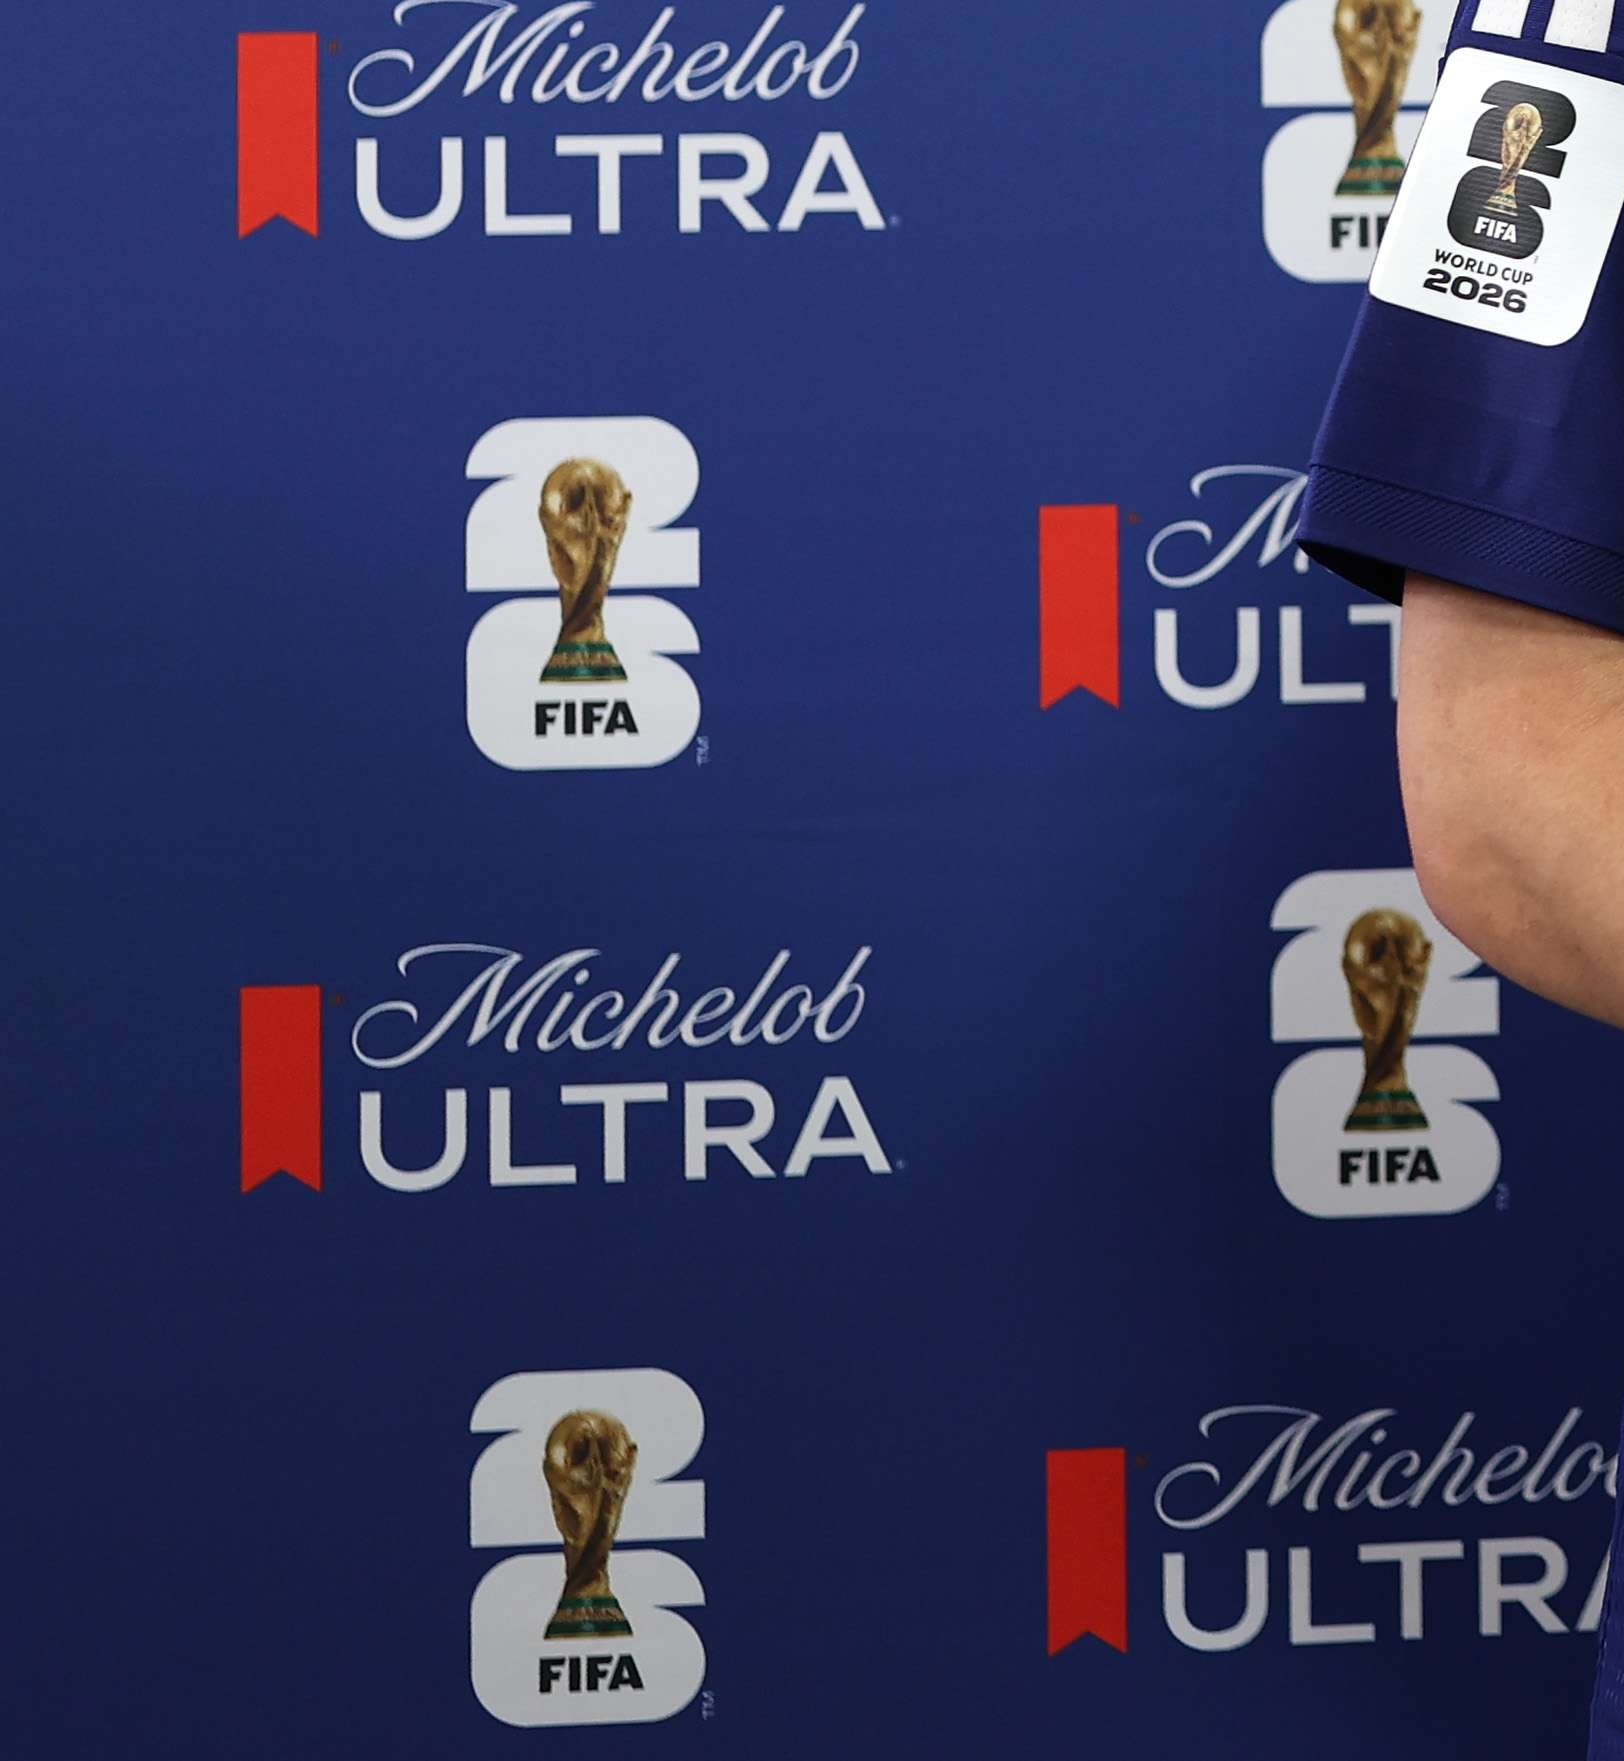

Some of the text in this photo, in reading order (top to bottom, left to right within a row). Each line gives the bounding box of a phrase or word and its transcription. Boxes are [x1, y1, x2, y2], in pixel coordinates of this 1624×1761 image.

[355, 131, 886, 240] ULTRA
[1473, 215, 1517, 243] FIFA
[1435, 248, 1534, 286] WORLD CUP
[1422, 268, 1528, 314] 2026
[1154, 603, 1402, 710] ULT
[534, 700, 639, 737] FIFA
[351, 943, 872, 1069] Michelob
[359, 1076, 892, 1192] ULTRA
[1339, 1147, 1441, 1186] FIFA
[1162, 1537, 1612, 1652] ULTR
[538, 1653, 644, 1694] FIFA
